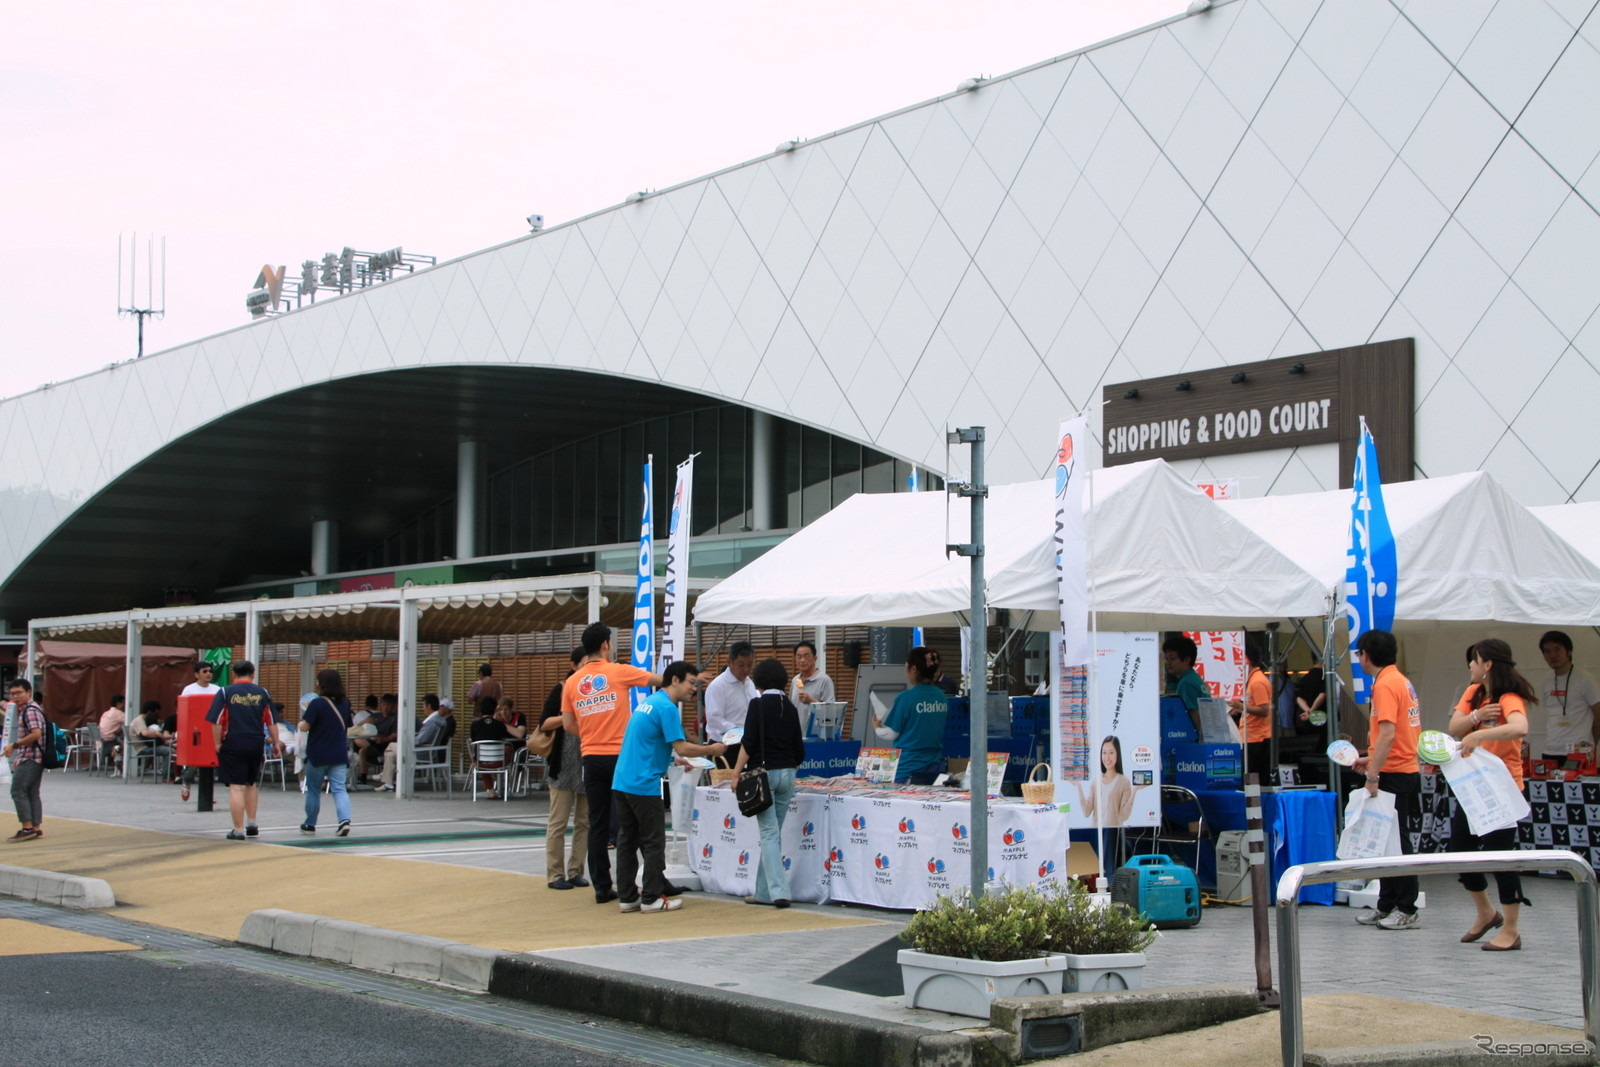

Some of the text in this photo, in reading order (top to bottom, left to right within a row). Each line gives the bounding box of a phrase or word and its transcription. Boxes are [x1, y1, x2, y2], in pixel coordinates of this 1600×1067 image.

[1108, 398, 1331, 455] SHOPPING & FOOD COURT
[576, 693, 617, 709] MAPPLE
